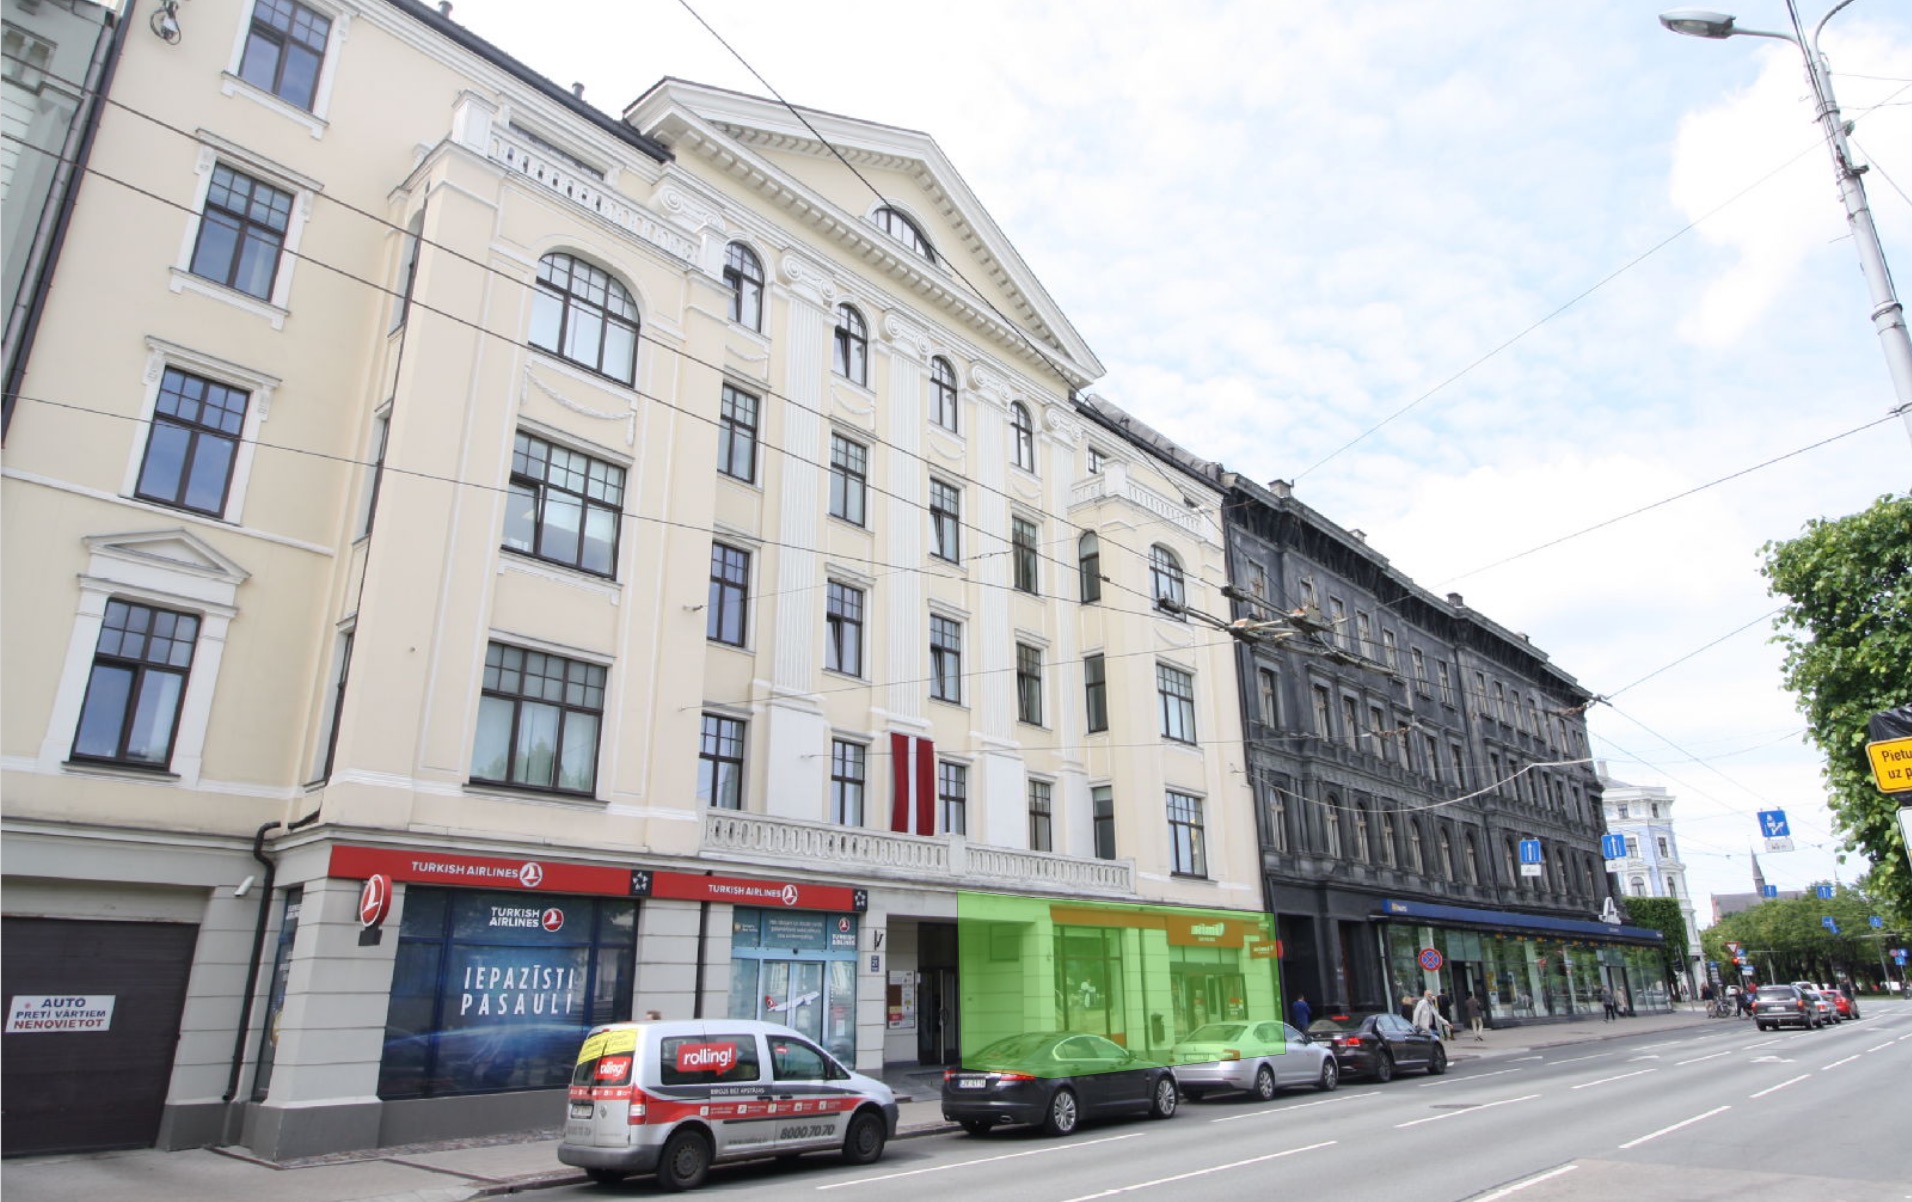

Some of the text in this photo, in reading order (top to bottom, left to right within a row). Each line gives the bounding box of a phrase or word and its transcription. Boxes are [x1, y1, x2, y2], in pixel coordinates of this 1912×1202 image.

[1888, 769, 1902, 779] uz
[411, 861, 519, 878] TURKISH AIRLINES
[708, 884, 782, 898] TURKISH AIRLINES
[488, 906, 540, 928] TURKISH AIRLINES
[464, 965, 574, 990] IEPAZĪSTI
[42, 998, 86, 1008] AUTO
[460, 993, 572, 1016] PASAULI
[14, 1019, 105, 1029] NENOVIETOT
[683, 1047, 732, 1067] rolling!
